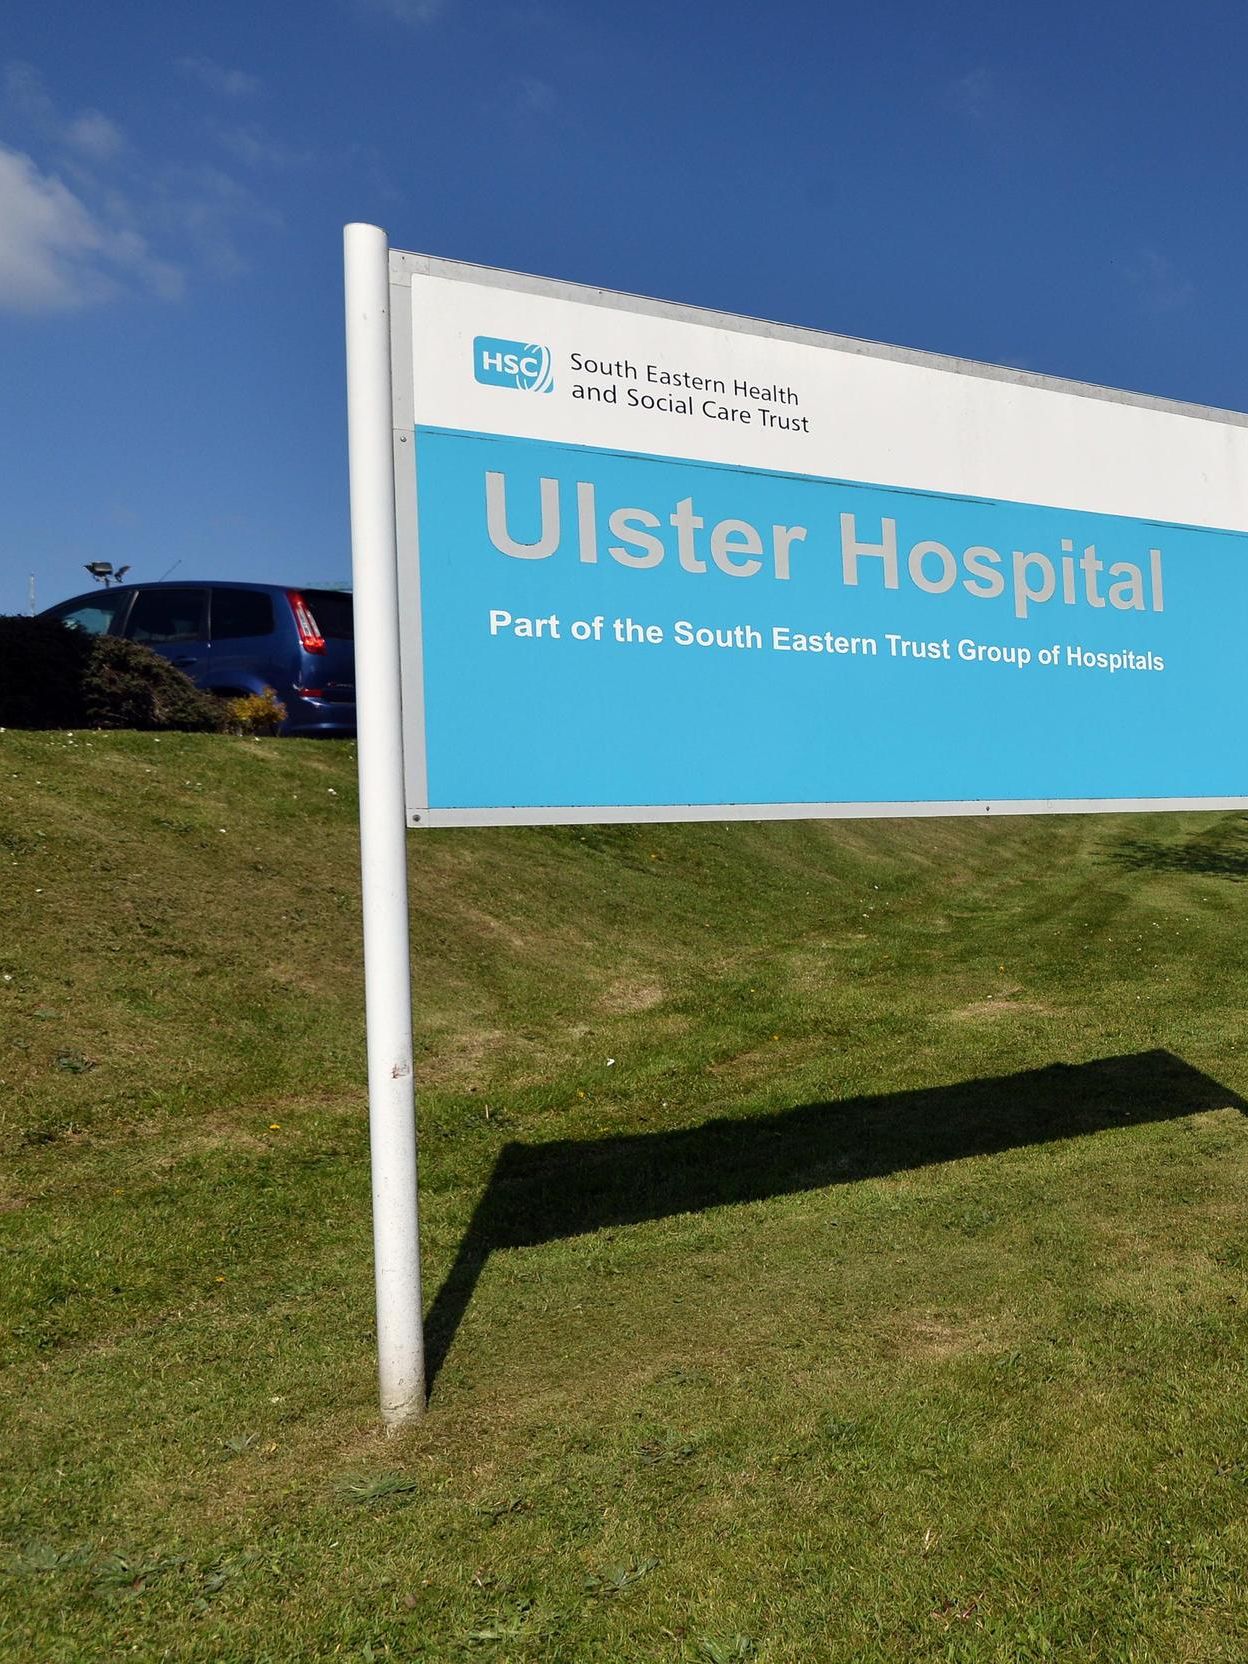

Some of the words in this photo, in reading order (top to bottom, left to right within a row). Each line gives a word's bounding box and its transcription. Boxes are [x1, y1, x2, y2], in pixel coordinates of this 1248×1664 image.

[482, 351, 538, 378] HSC
[571, 353, 637, 380] South
[646, 364, 725, 394] Eastern
[734, 380, 799, 406] Health
[572, 384, 617, 404] and
[627, 388, 693, 416] Social
[702, 400, 752, 424] Care
[758, 409, 810, 434] Trust
[485, 472, 807, 581] Ulster
[839, 511, 1165, 619] Hospital
[489, 609, 561, 640] Part
[570, 616, 605, 641] of
[612, 618, 664, 645] the
[673, 620, 763, 649] South
[772, 626, 878, 656] Eastern
[884, 633, 952, 660] Trust
[957, 638, 1032, 669] Group
[1038, 644, 1061, 666] of
[1066, 645, 1165, 673] Hospitals
